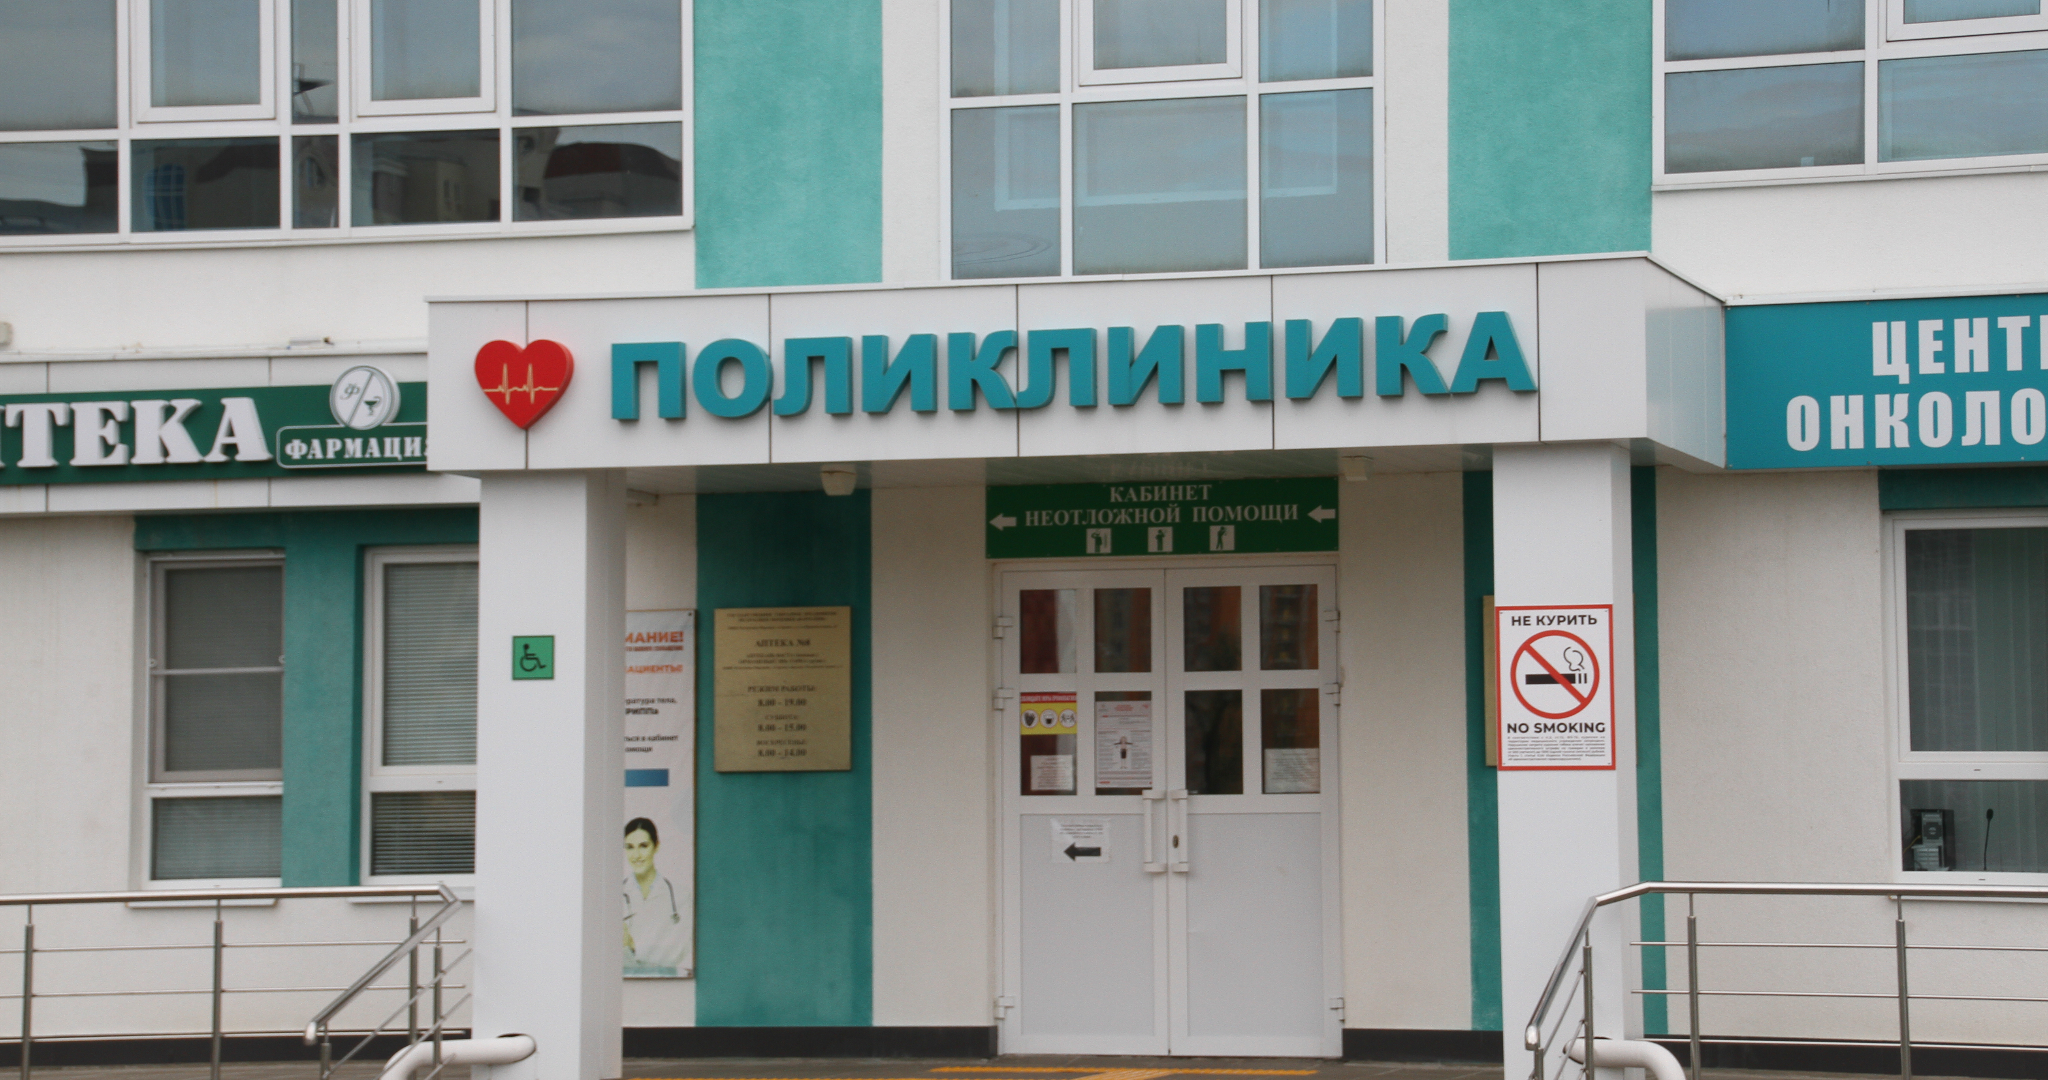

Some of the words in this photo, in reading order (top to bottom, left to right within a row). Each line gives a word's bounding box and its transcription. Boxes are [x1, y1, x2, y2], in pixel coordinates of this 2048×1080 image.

[611, 310, 1539, 423] ПОЛИКЛИНИКА
[1786, 388, 2047, 452] ОНКОЛО
[0, 397, 273, 468] ТЕКА
[285, 436, 427, 460] ФАРМАЦИ
[1109, 484, 1213, 503] КАБИНЕТ
[1025, 503, 1182, 526] НЕОТЛОЖНОЙ
[1192, 504, 1299, 524] ПОМОЩИ
[1511, 616, 1531, 626] НЕ
[1536, 614, 1598, 626] КУРИТЬ
[755, 638, 794, 647] АПТЕКА
[625, 664, 684, 674] АЦИЕНТЫ!
[1507, 723, 1529, 734] NO
[1534, 722, 1606, 734] SMOKING
